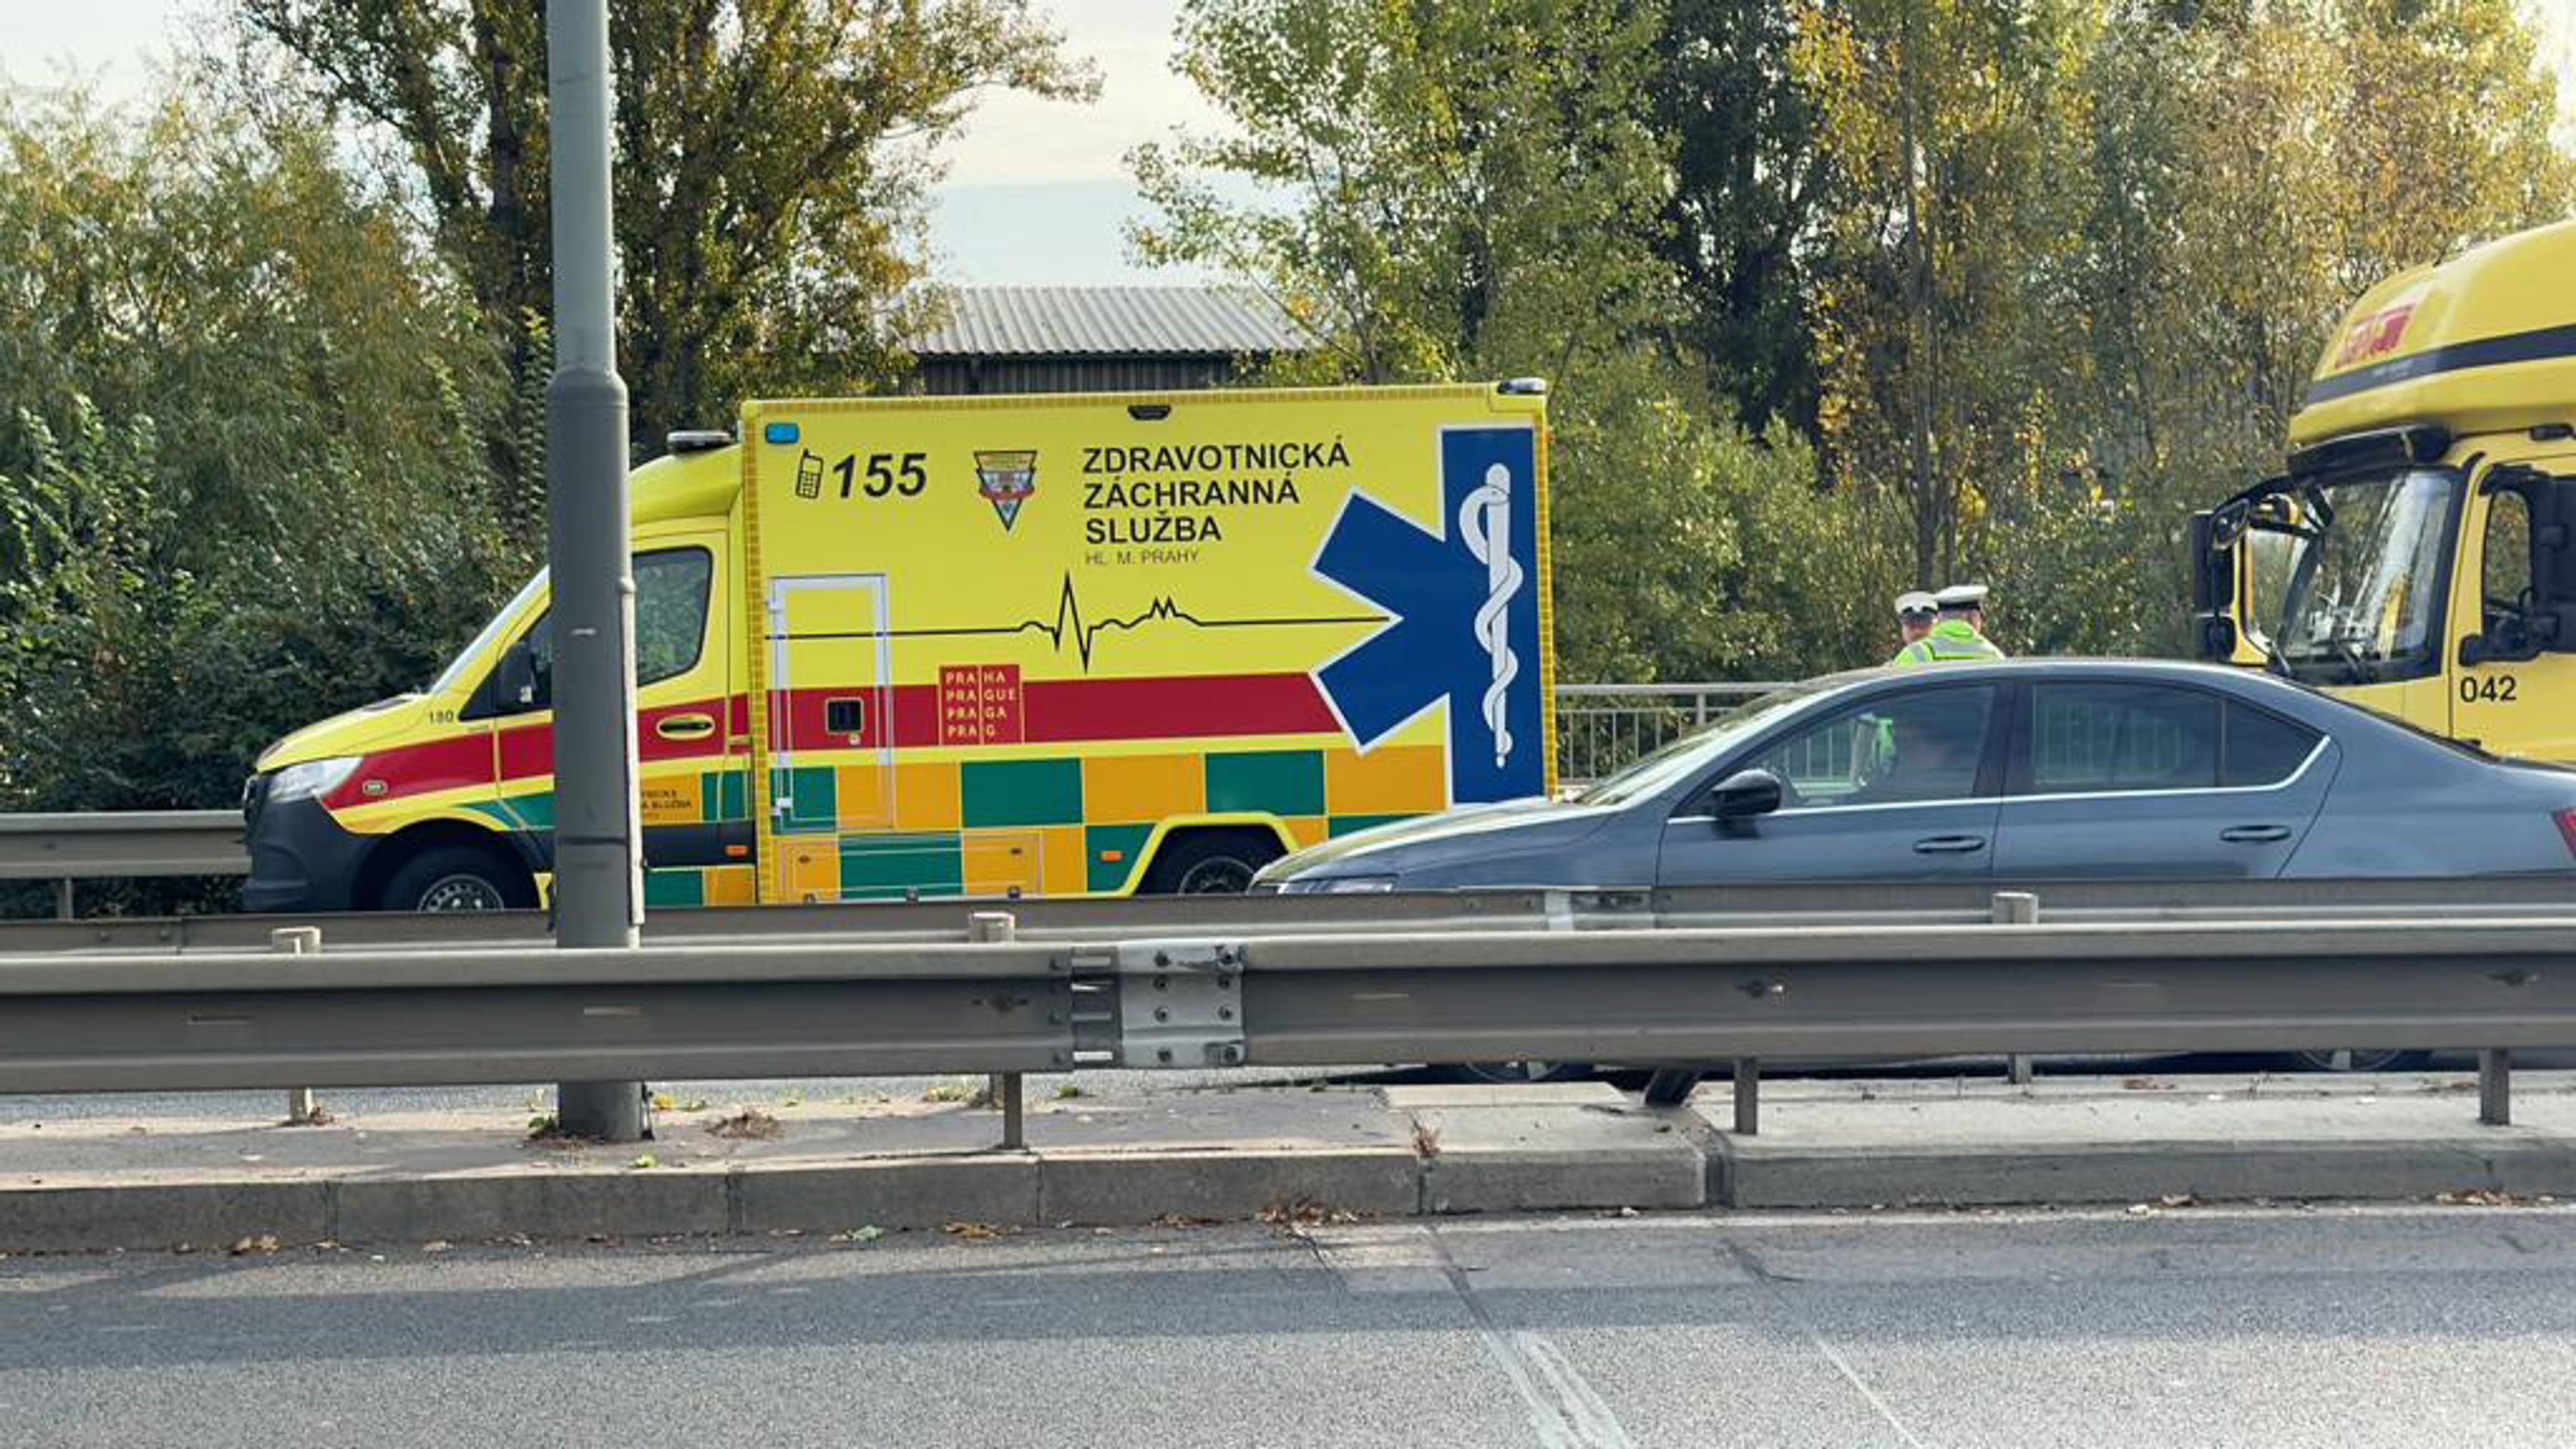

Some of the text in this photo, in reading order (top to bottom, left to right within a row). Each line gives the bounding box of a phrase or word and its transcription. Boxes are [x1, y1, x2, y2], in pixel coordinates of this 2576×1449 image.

[1083, 435, 1350, 474] ZDRAVOTNICKÁ
[833, 453, 927, 498] 155
[1084, 472, 1300, 509] ZÁCHRANNÁ
[1086, 511, 1222, 544] SLUŽBA
[1141, 546, 1200, 564] PRAHY
[2461, 675, 2517, 703] 042
